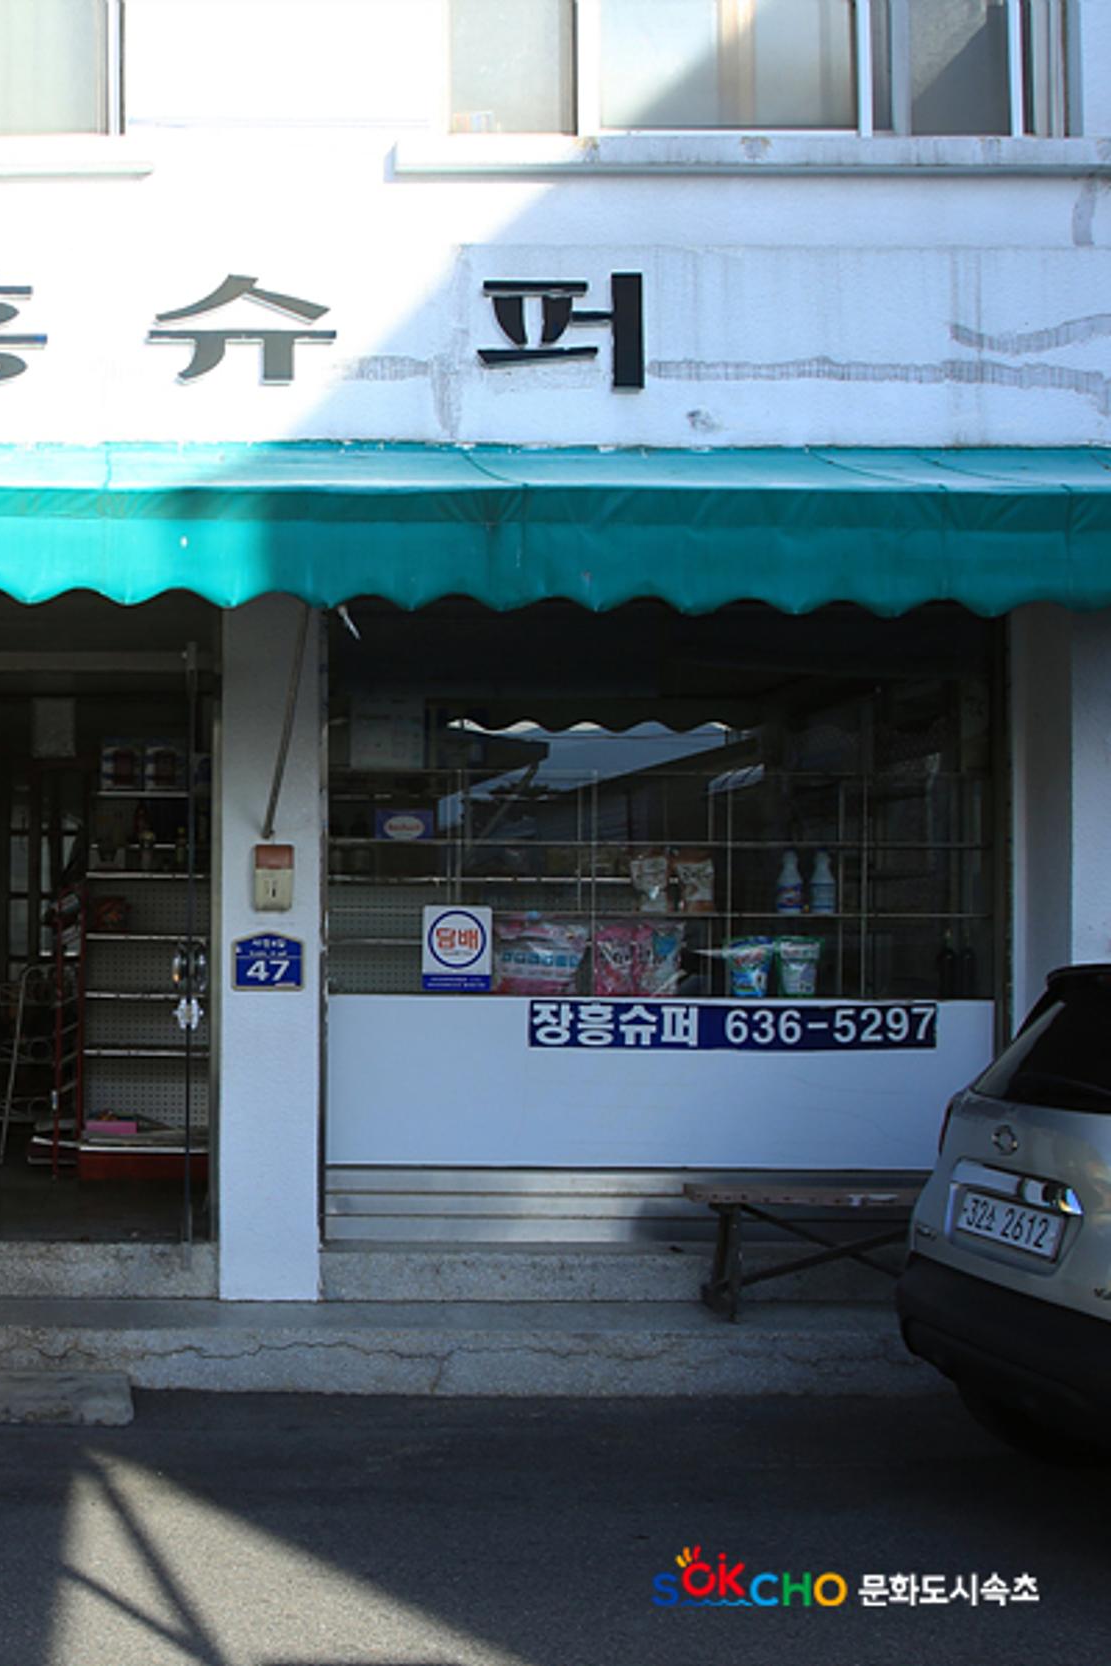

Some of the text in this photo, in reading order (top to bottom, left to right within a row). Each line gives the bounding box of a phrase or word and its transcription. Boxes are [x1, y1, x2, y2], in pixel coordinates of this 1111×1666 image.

[435, 927, 479, 949] 담배
[246, 960, 290, 981] 47
[532, 1002, 936, 1047] 장흥슈퍼 636-5297
[1001, 1208, 1050, 1248] 2612
